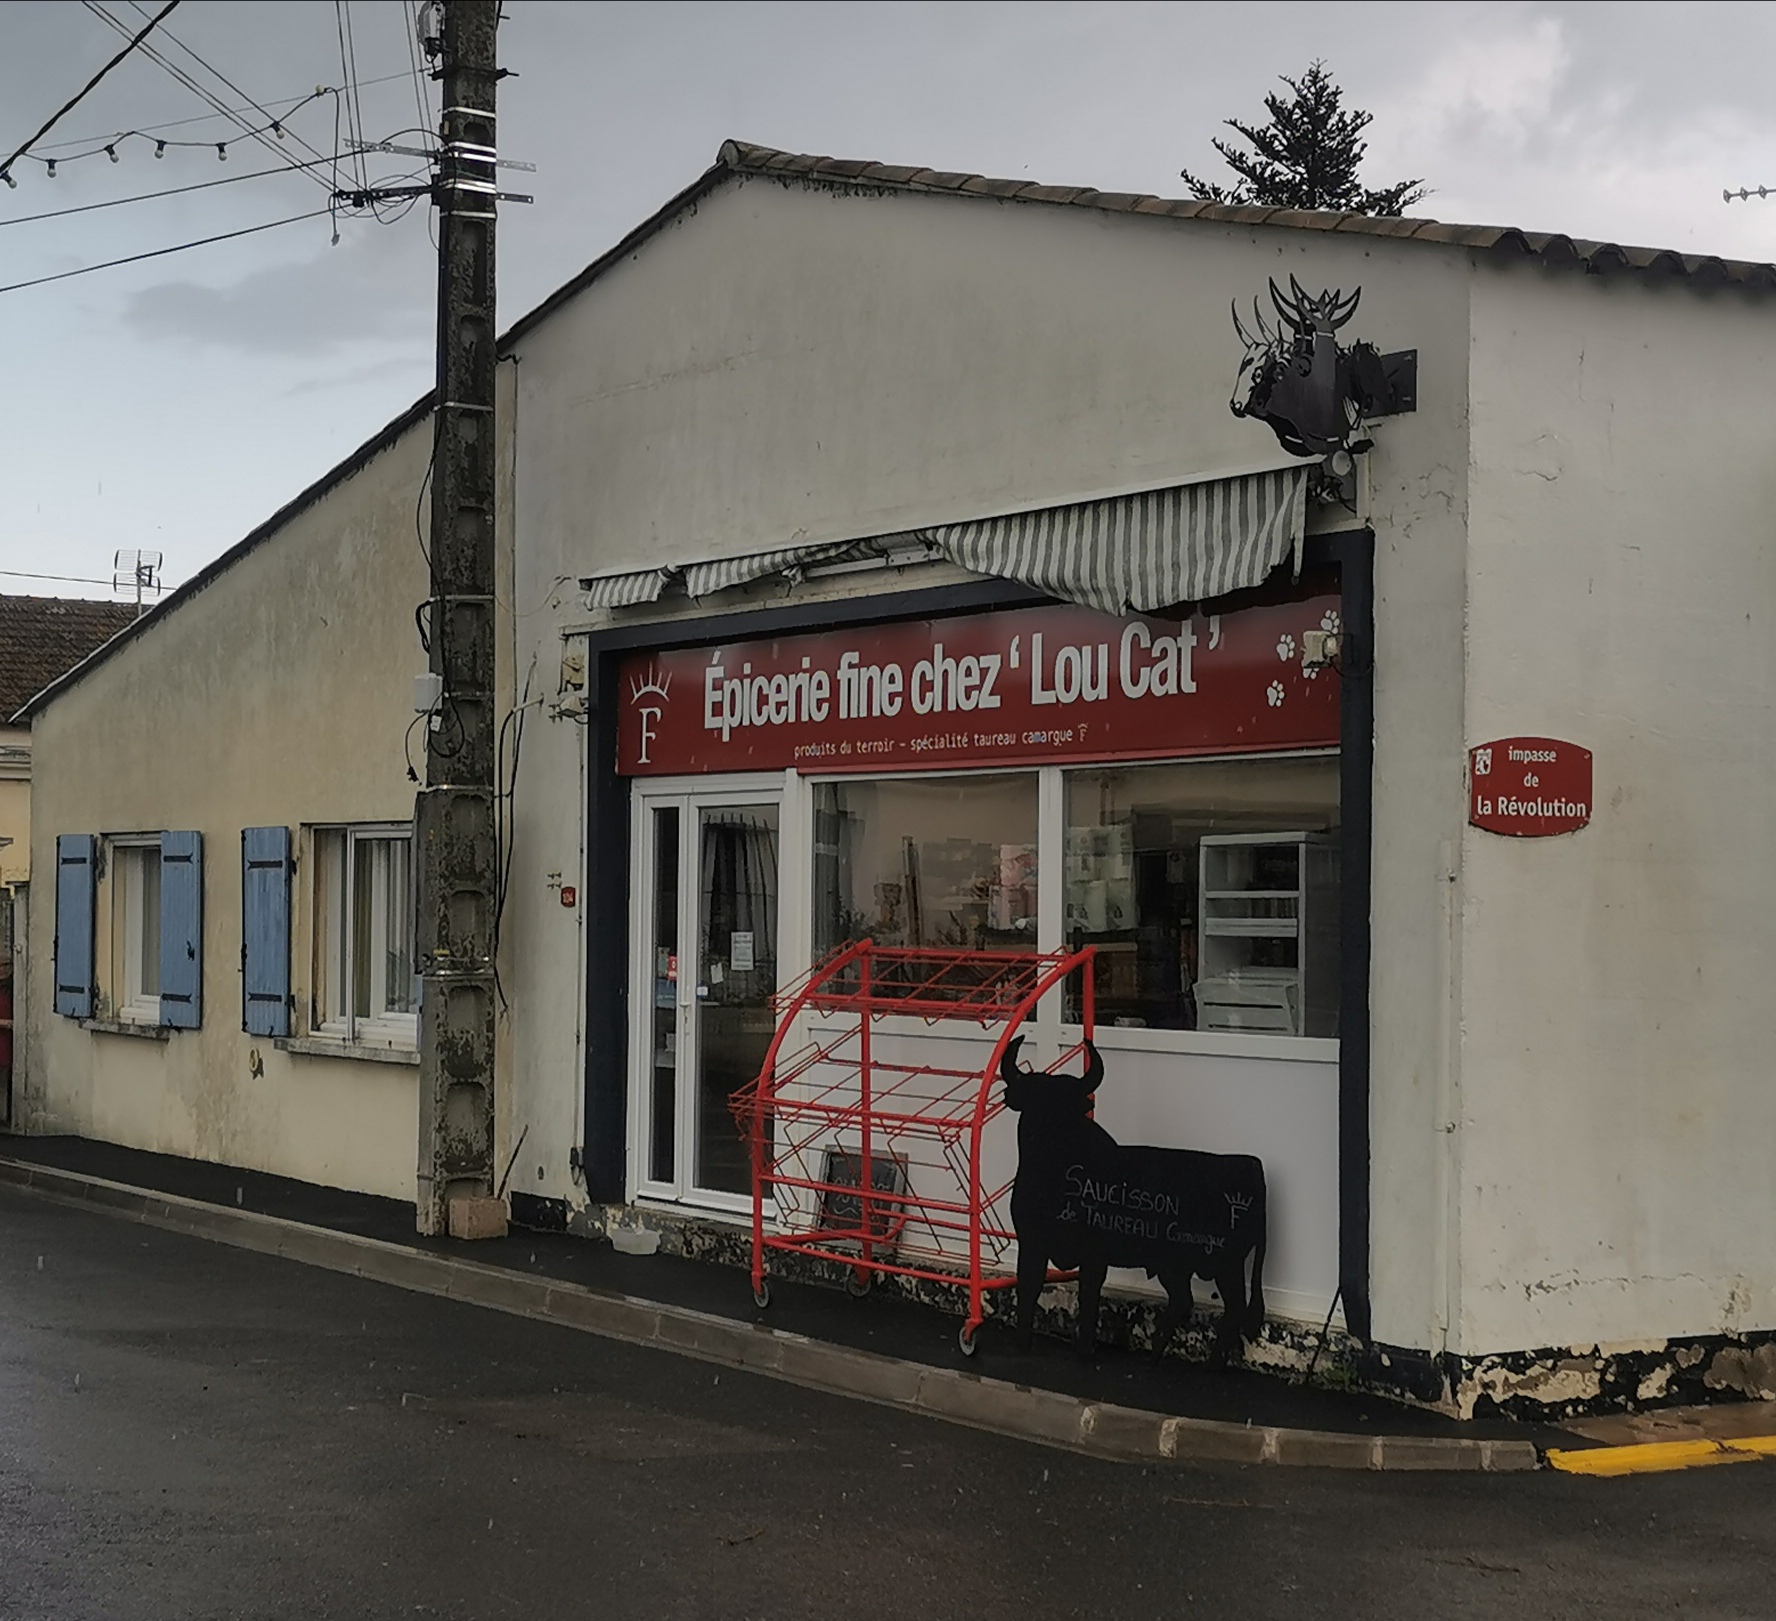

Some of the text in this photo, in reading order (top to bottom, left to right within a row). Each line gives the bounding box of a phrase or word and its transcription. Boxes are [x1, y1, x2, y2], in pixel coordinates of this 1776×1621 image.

[704, 650, 831, 742] Épicerie
[837, 651, 903, 720] fine
[911, 643, 1001, 715] chez
[794, 742, 836, 760] produits
[840, 739, 852, 755] du
[856, 737, 895, 754] terroir
[910, 732, 969, 754] spécialité
[974, 732, 1016, 747] taureau
[1022, 729, 1074, 747] camargue
[1508, 745, 1557, 764] impasse
[1523, 772, 1540, 787] de
[1477, 795, 1586, 817] la Révolution
[1081, 1201, 1159, 1239] TAUREAU
